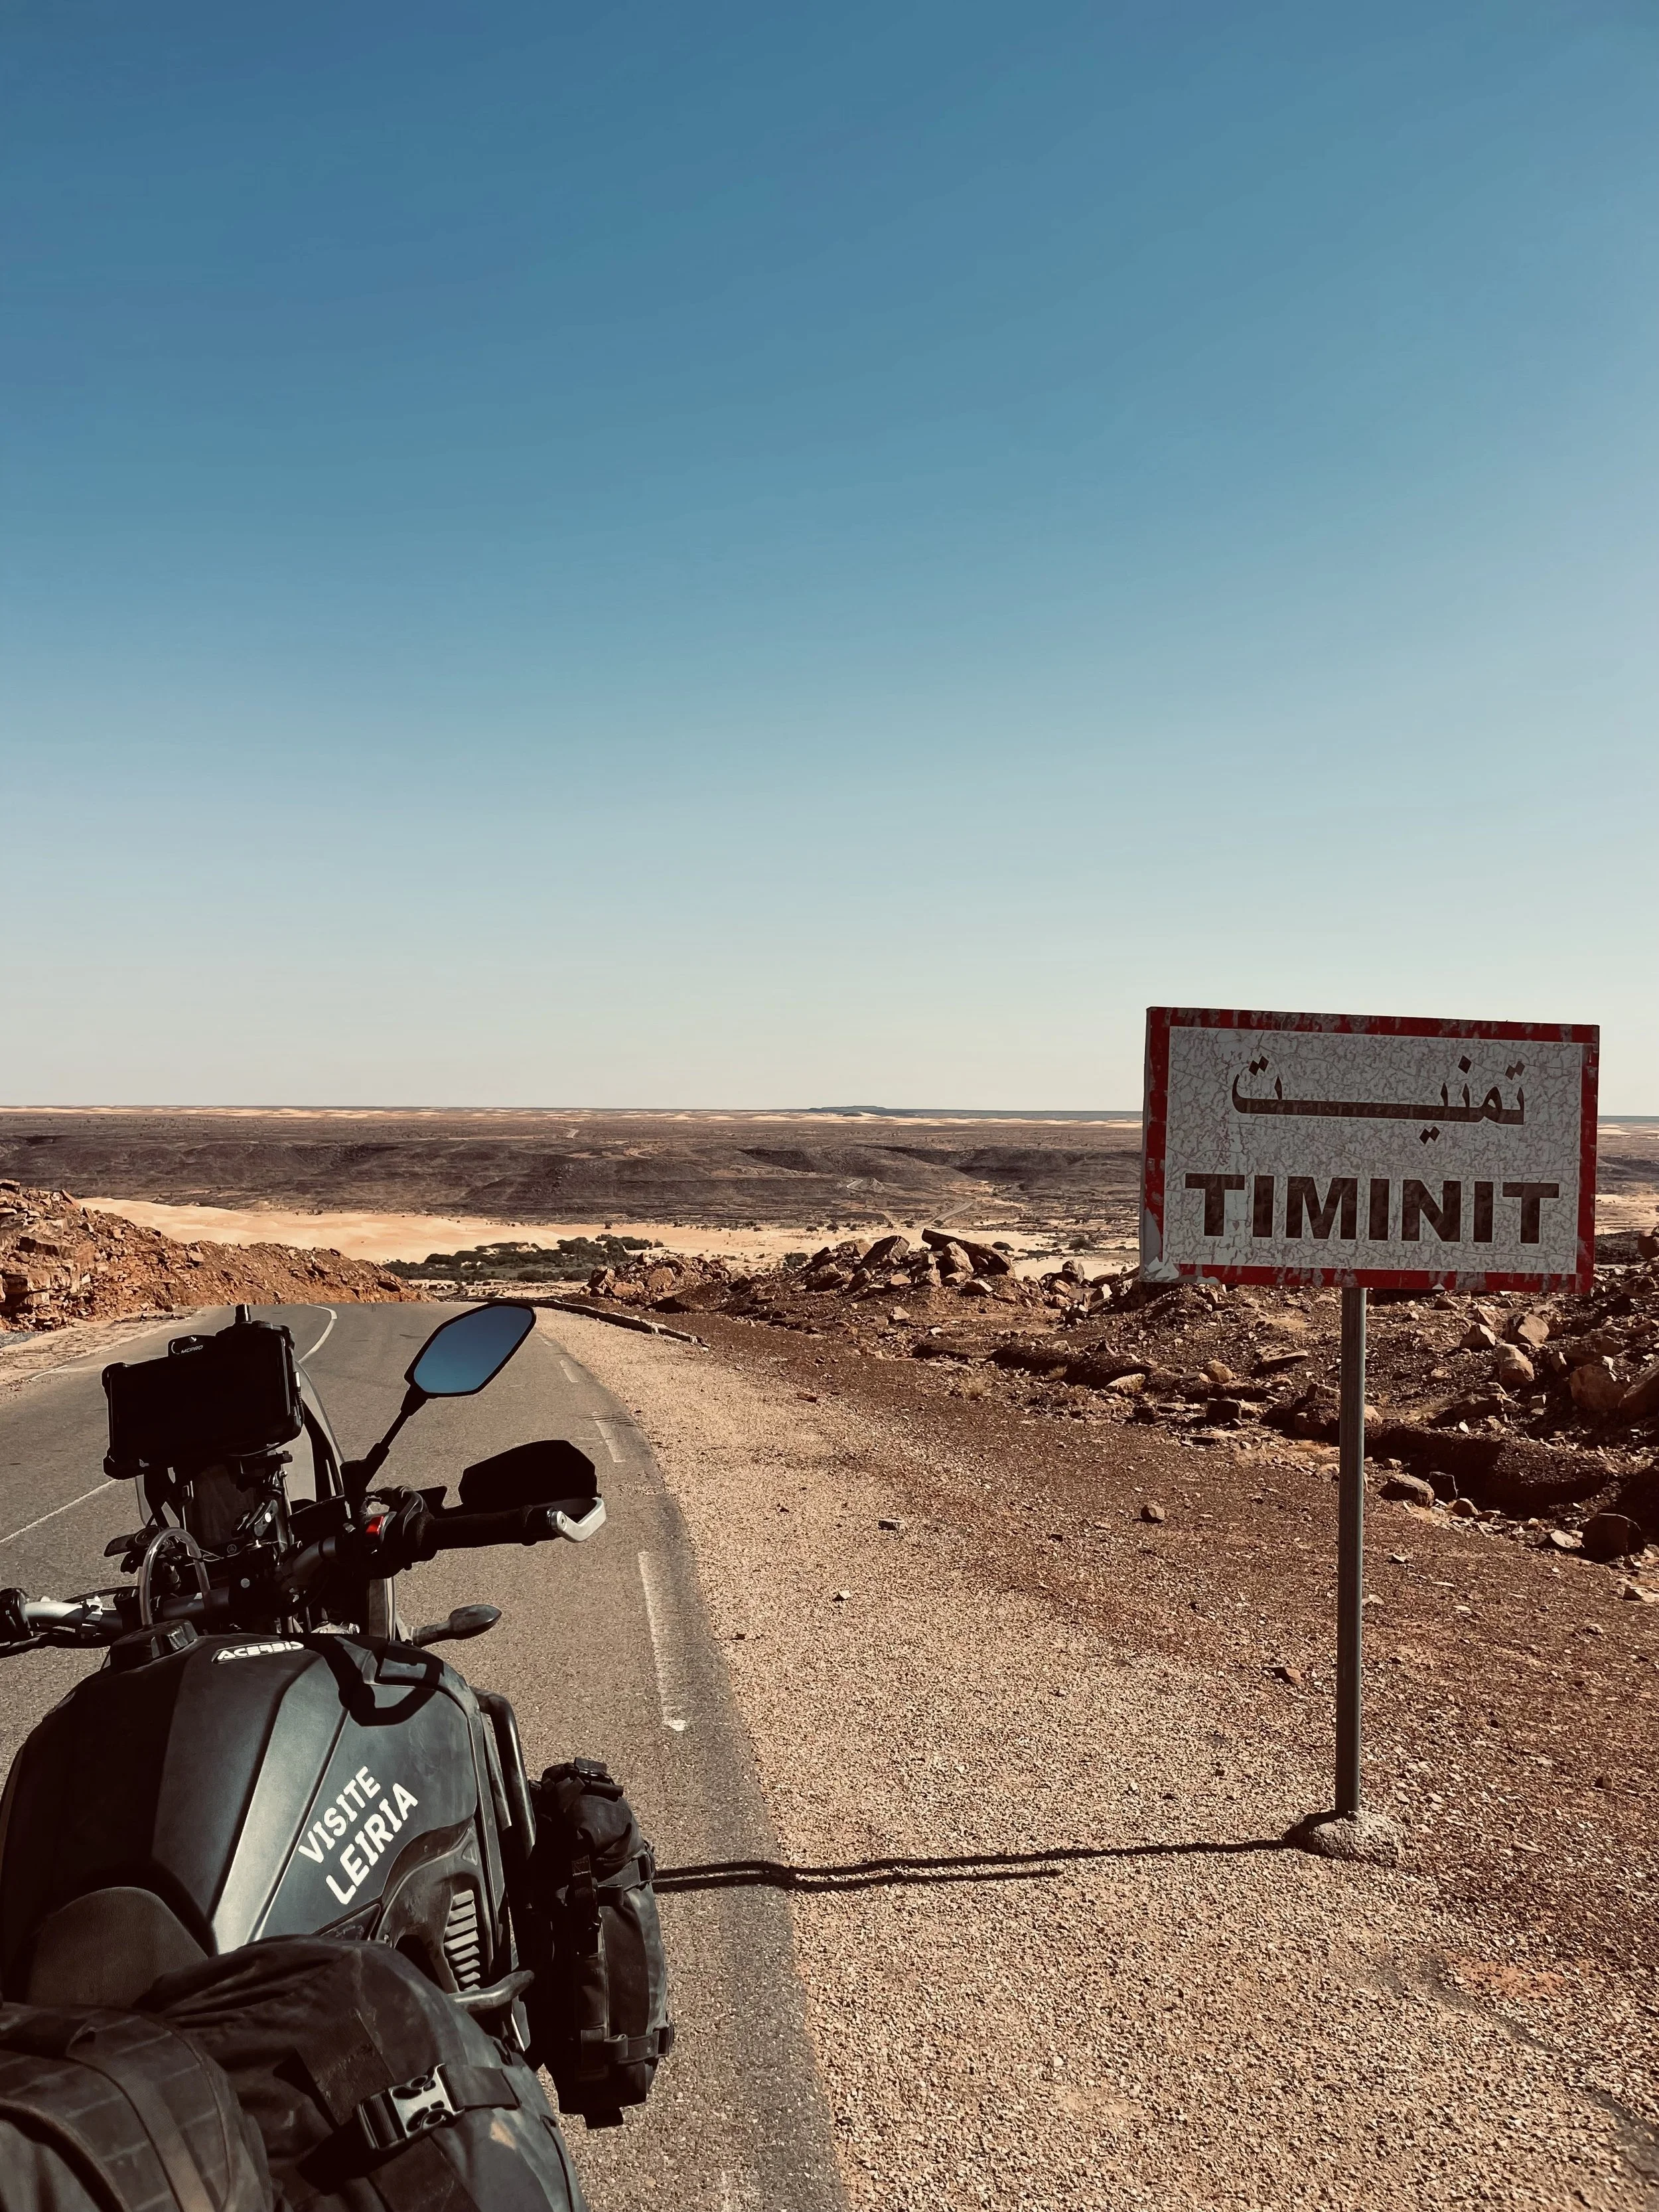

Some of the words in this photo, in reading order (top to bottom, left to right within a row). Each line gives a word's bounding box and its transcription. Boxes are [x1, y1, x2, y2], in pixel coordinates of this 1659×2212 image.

[1185, 1173, 1559, 1244] TIMINIT
[217, 1641, 305, 1660] ACERBIS
[299, 1765, 381, 1864] VISITE
[325, 1783, 418, 1905] LEIRIA
